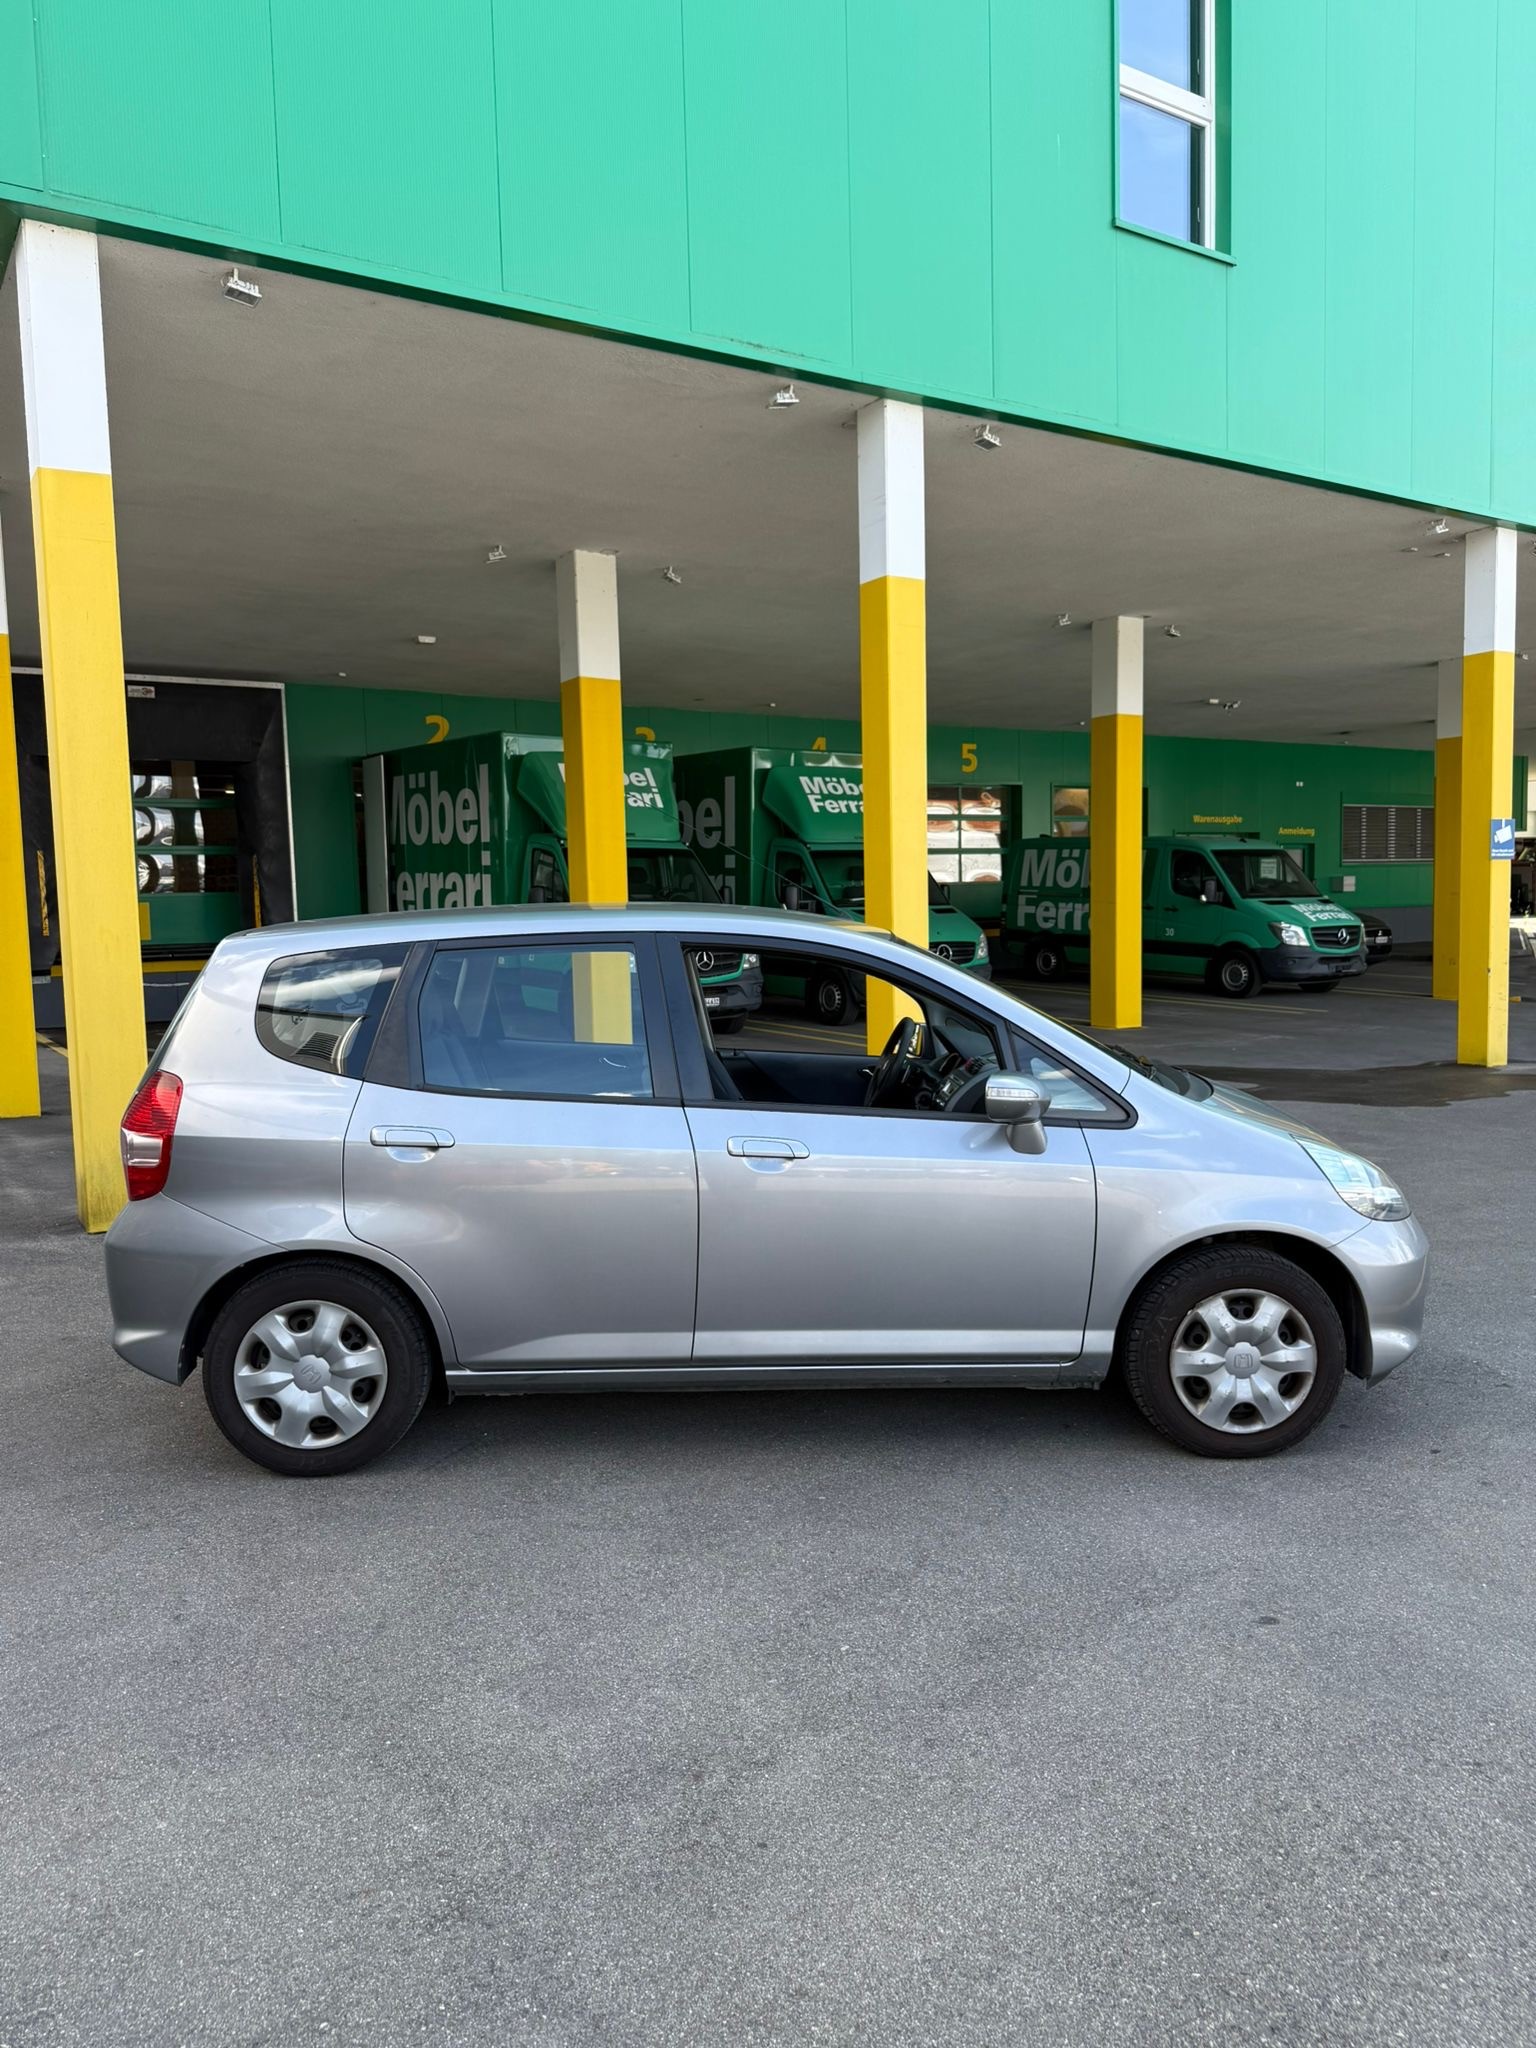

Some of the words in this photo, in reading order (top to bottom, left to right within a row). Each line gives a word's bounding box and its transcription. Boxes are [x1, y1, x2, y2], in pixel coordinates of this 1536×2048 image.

[961, 743, 978, 773] 5
[799, 776, 864, 796] Möb
[807, 794, 864, 813] Ferr
[1193, 814, 1243, 825] Warenausgabe
[1278, 827, 1315, 837] Anmeldung
[395, 850, 492, 911] errari
[1016, 889, 1091, 931] Ferr
[1164, 927, 1175, 937] 30
